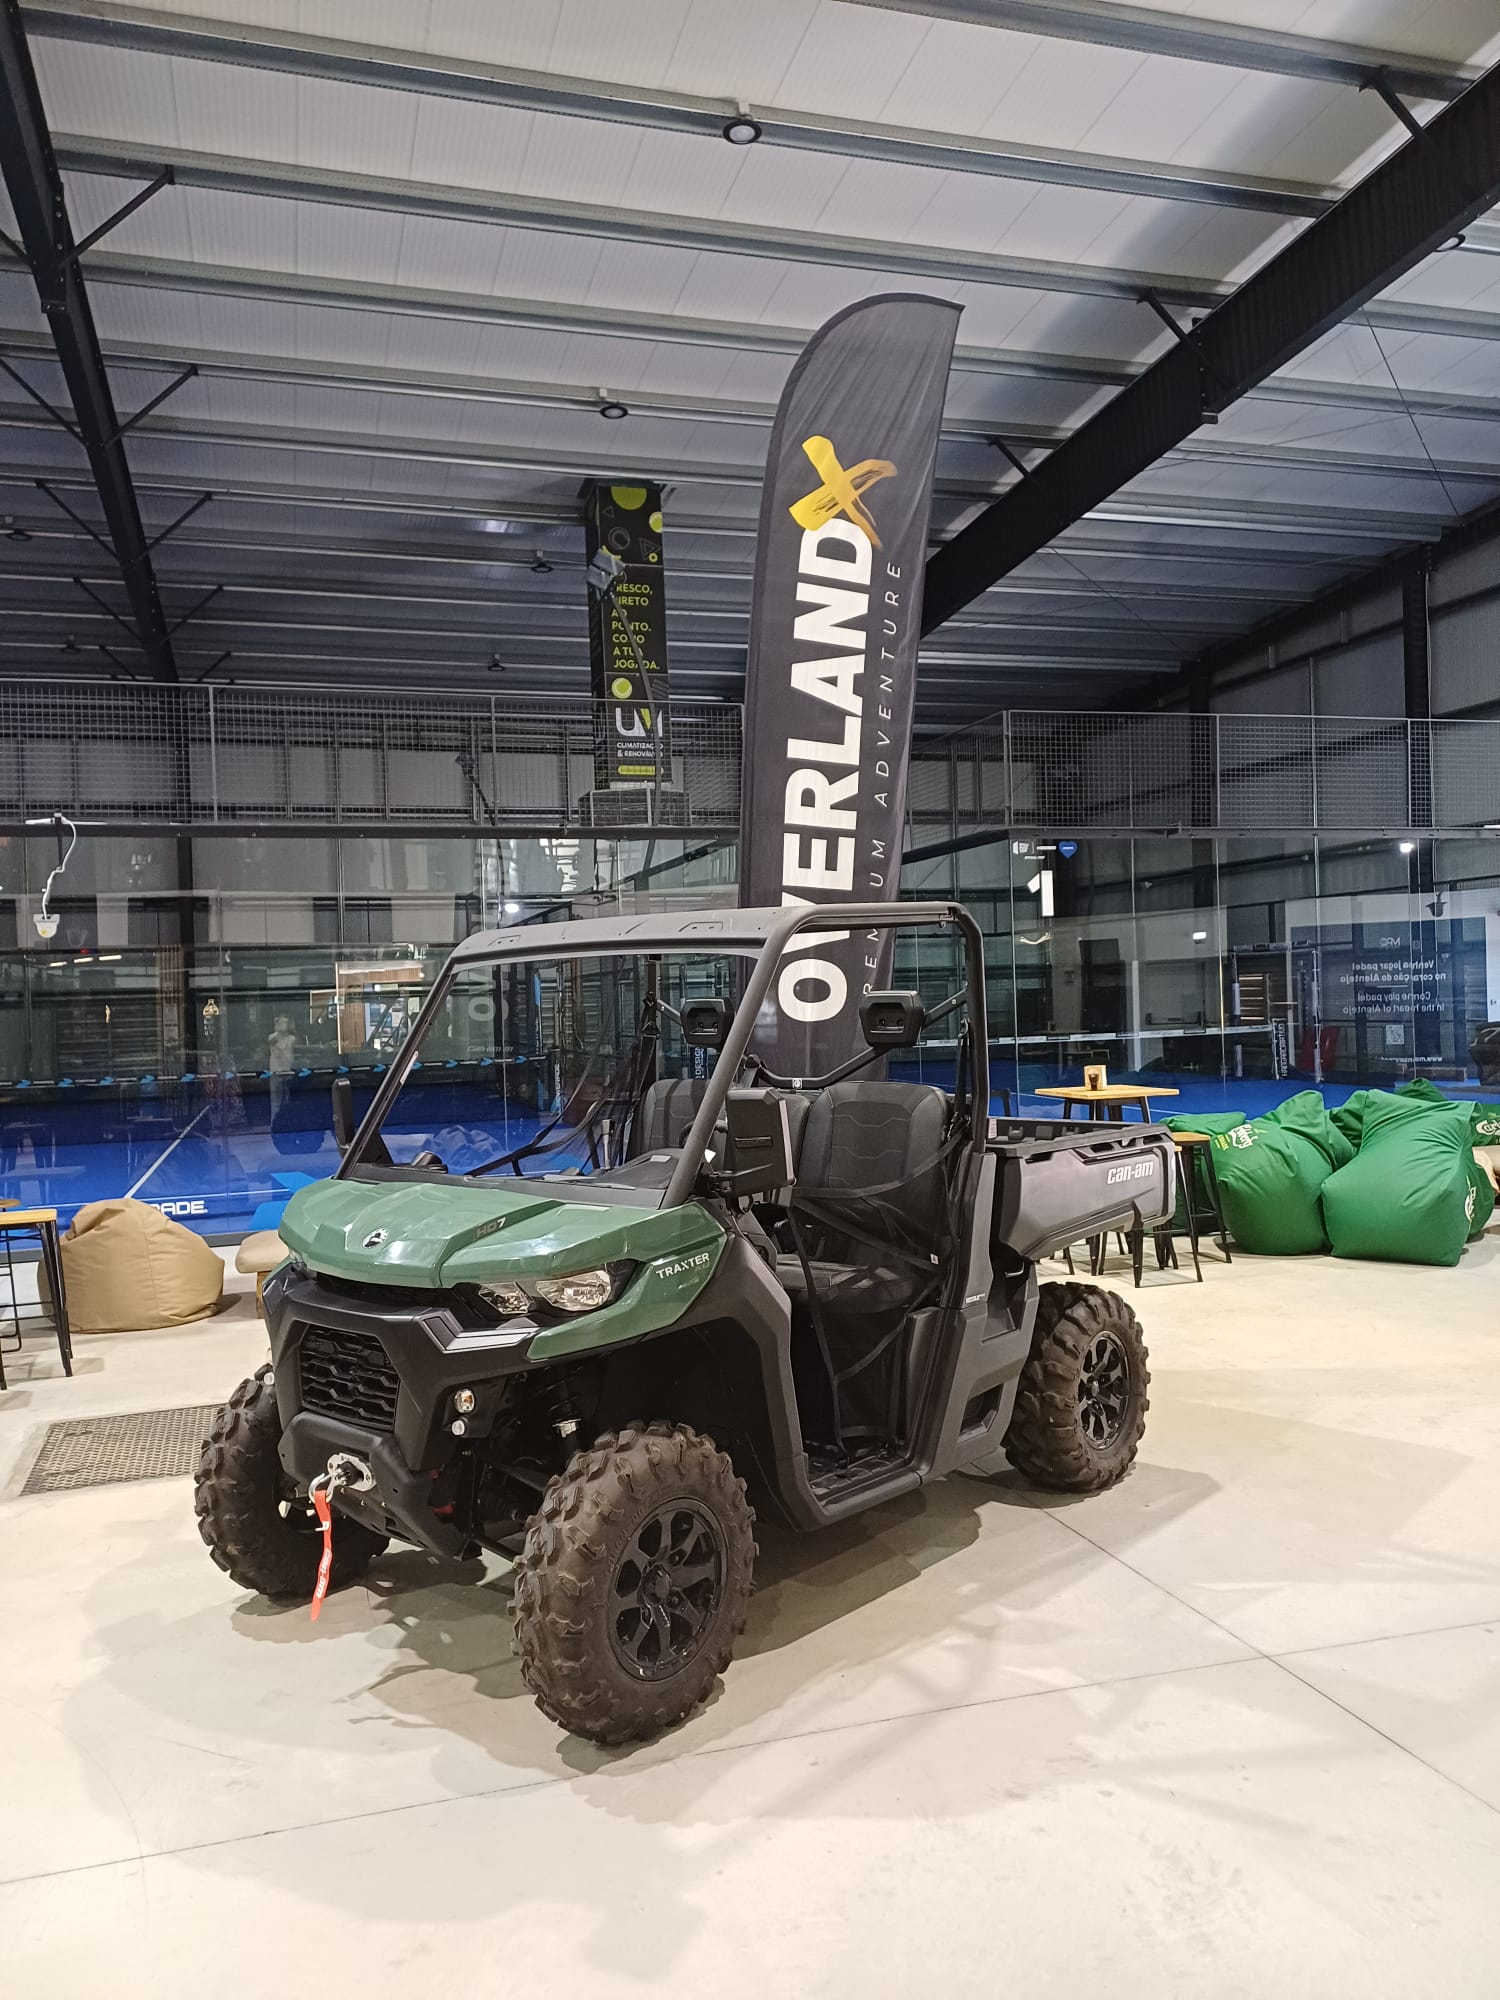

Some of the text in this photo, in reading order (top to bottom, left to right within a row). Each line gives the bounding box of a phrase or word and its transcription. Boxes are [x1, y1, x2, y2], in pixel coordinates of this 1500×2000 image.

[615, 583, 653, 595] RESCO,
[618, 596, 649, 606] IRETO
[612, 633, 645, 644] COO
[613, 646, 621, 656] A
[874, 561, 901, 809] ADVENTURE
[617, 749, 624, 758] &
[476, 1216, 507, 1239] HD7
[655, 1252, 711, 1279] TRAXTER
